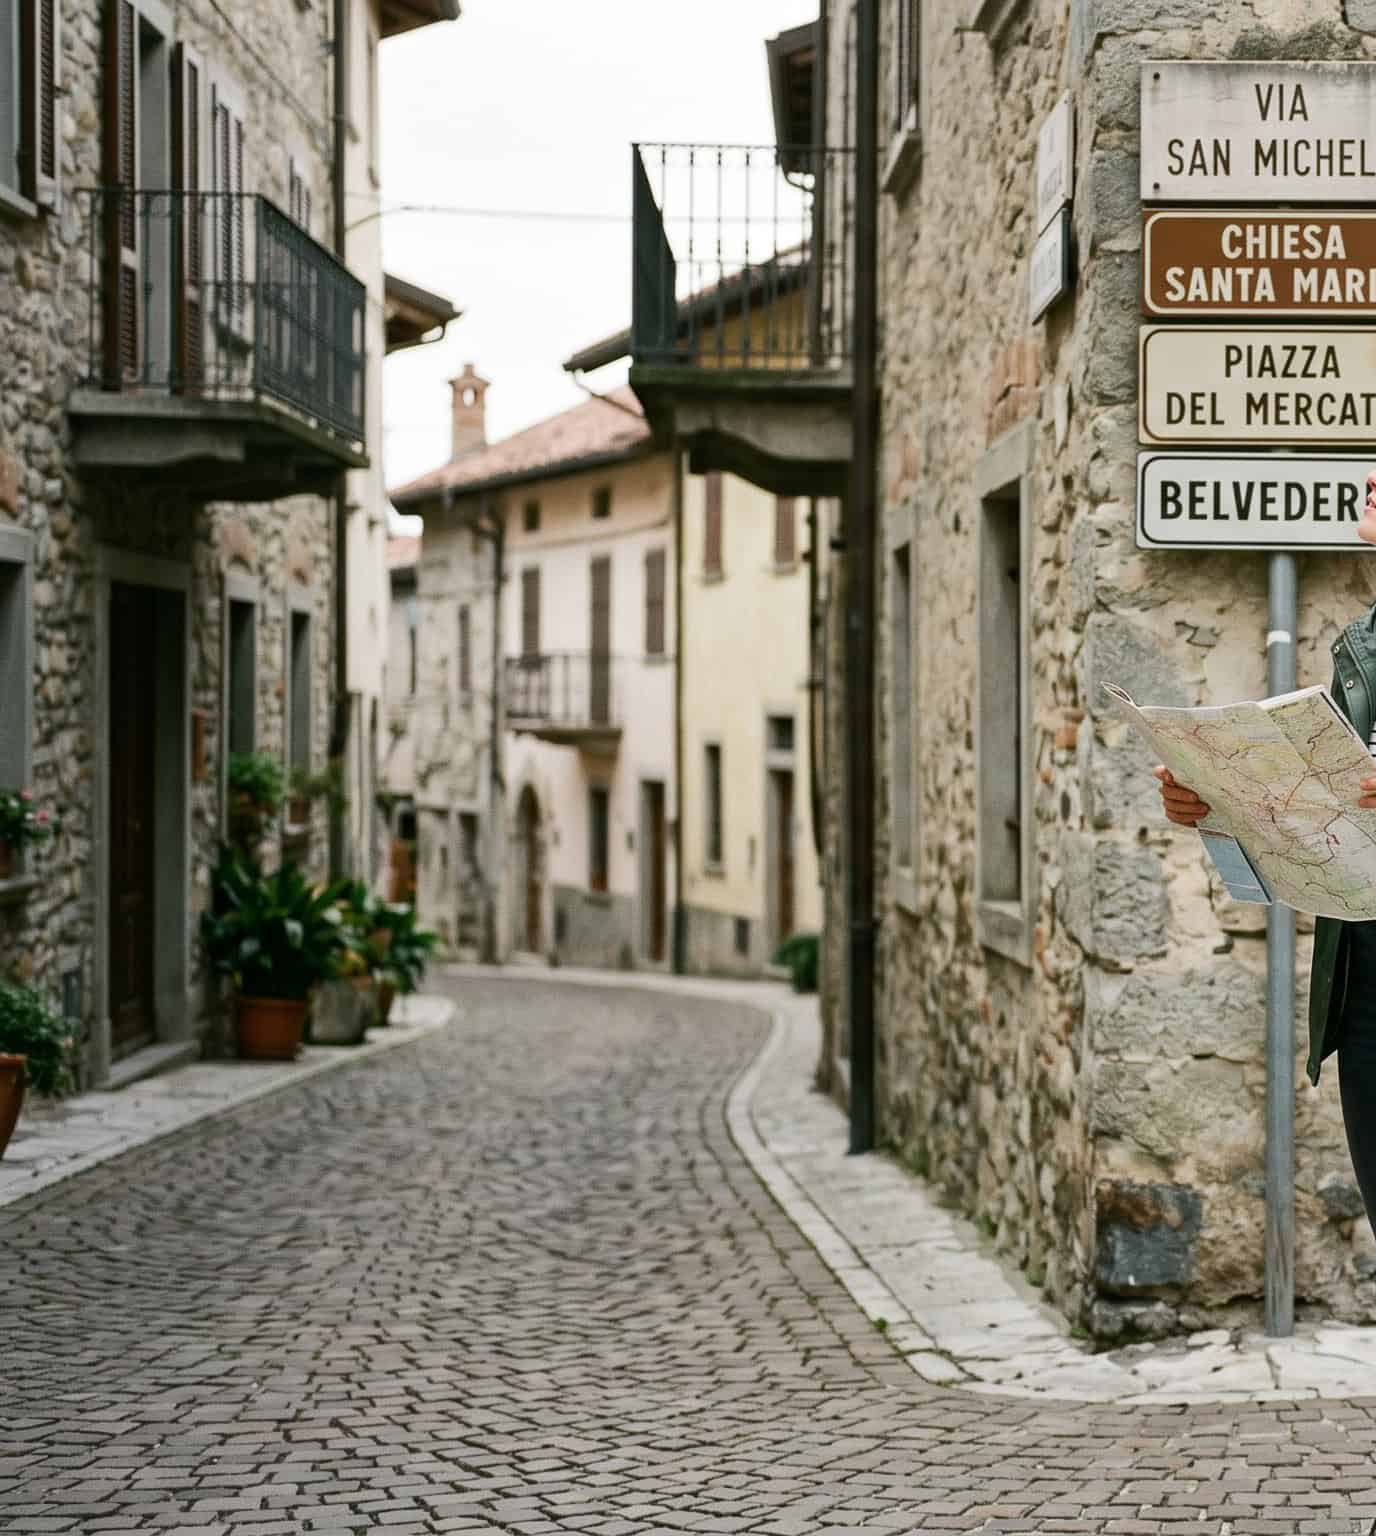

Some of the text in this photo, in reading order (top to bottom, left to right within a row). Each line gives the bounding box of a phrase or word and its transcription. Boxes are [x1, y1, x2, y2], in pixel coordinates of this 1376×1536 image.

[1254, 83, 1309, 122] VIA
[1167, 138, 1231, 177] SAN
[1221, 224, 1347, 260] CHIESA
[1165, 267, 1276, 302] SANTA
[1225, 344, 1341, 379] PIAZZA
[1166, 392, 1225, 426] DEL
[1160, 480, 1372, 522] BELVEDER
